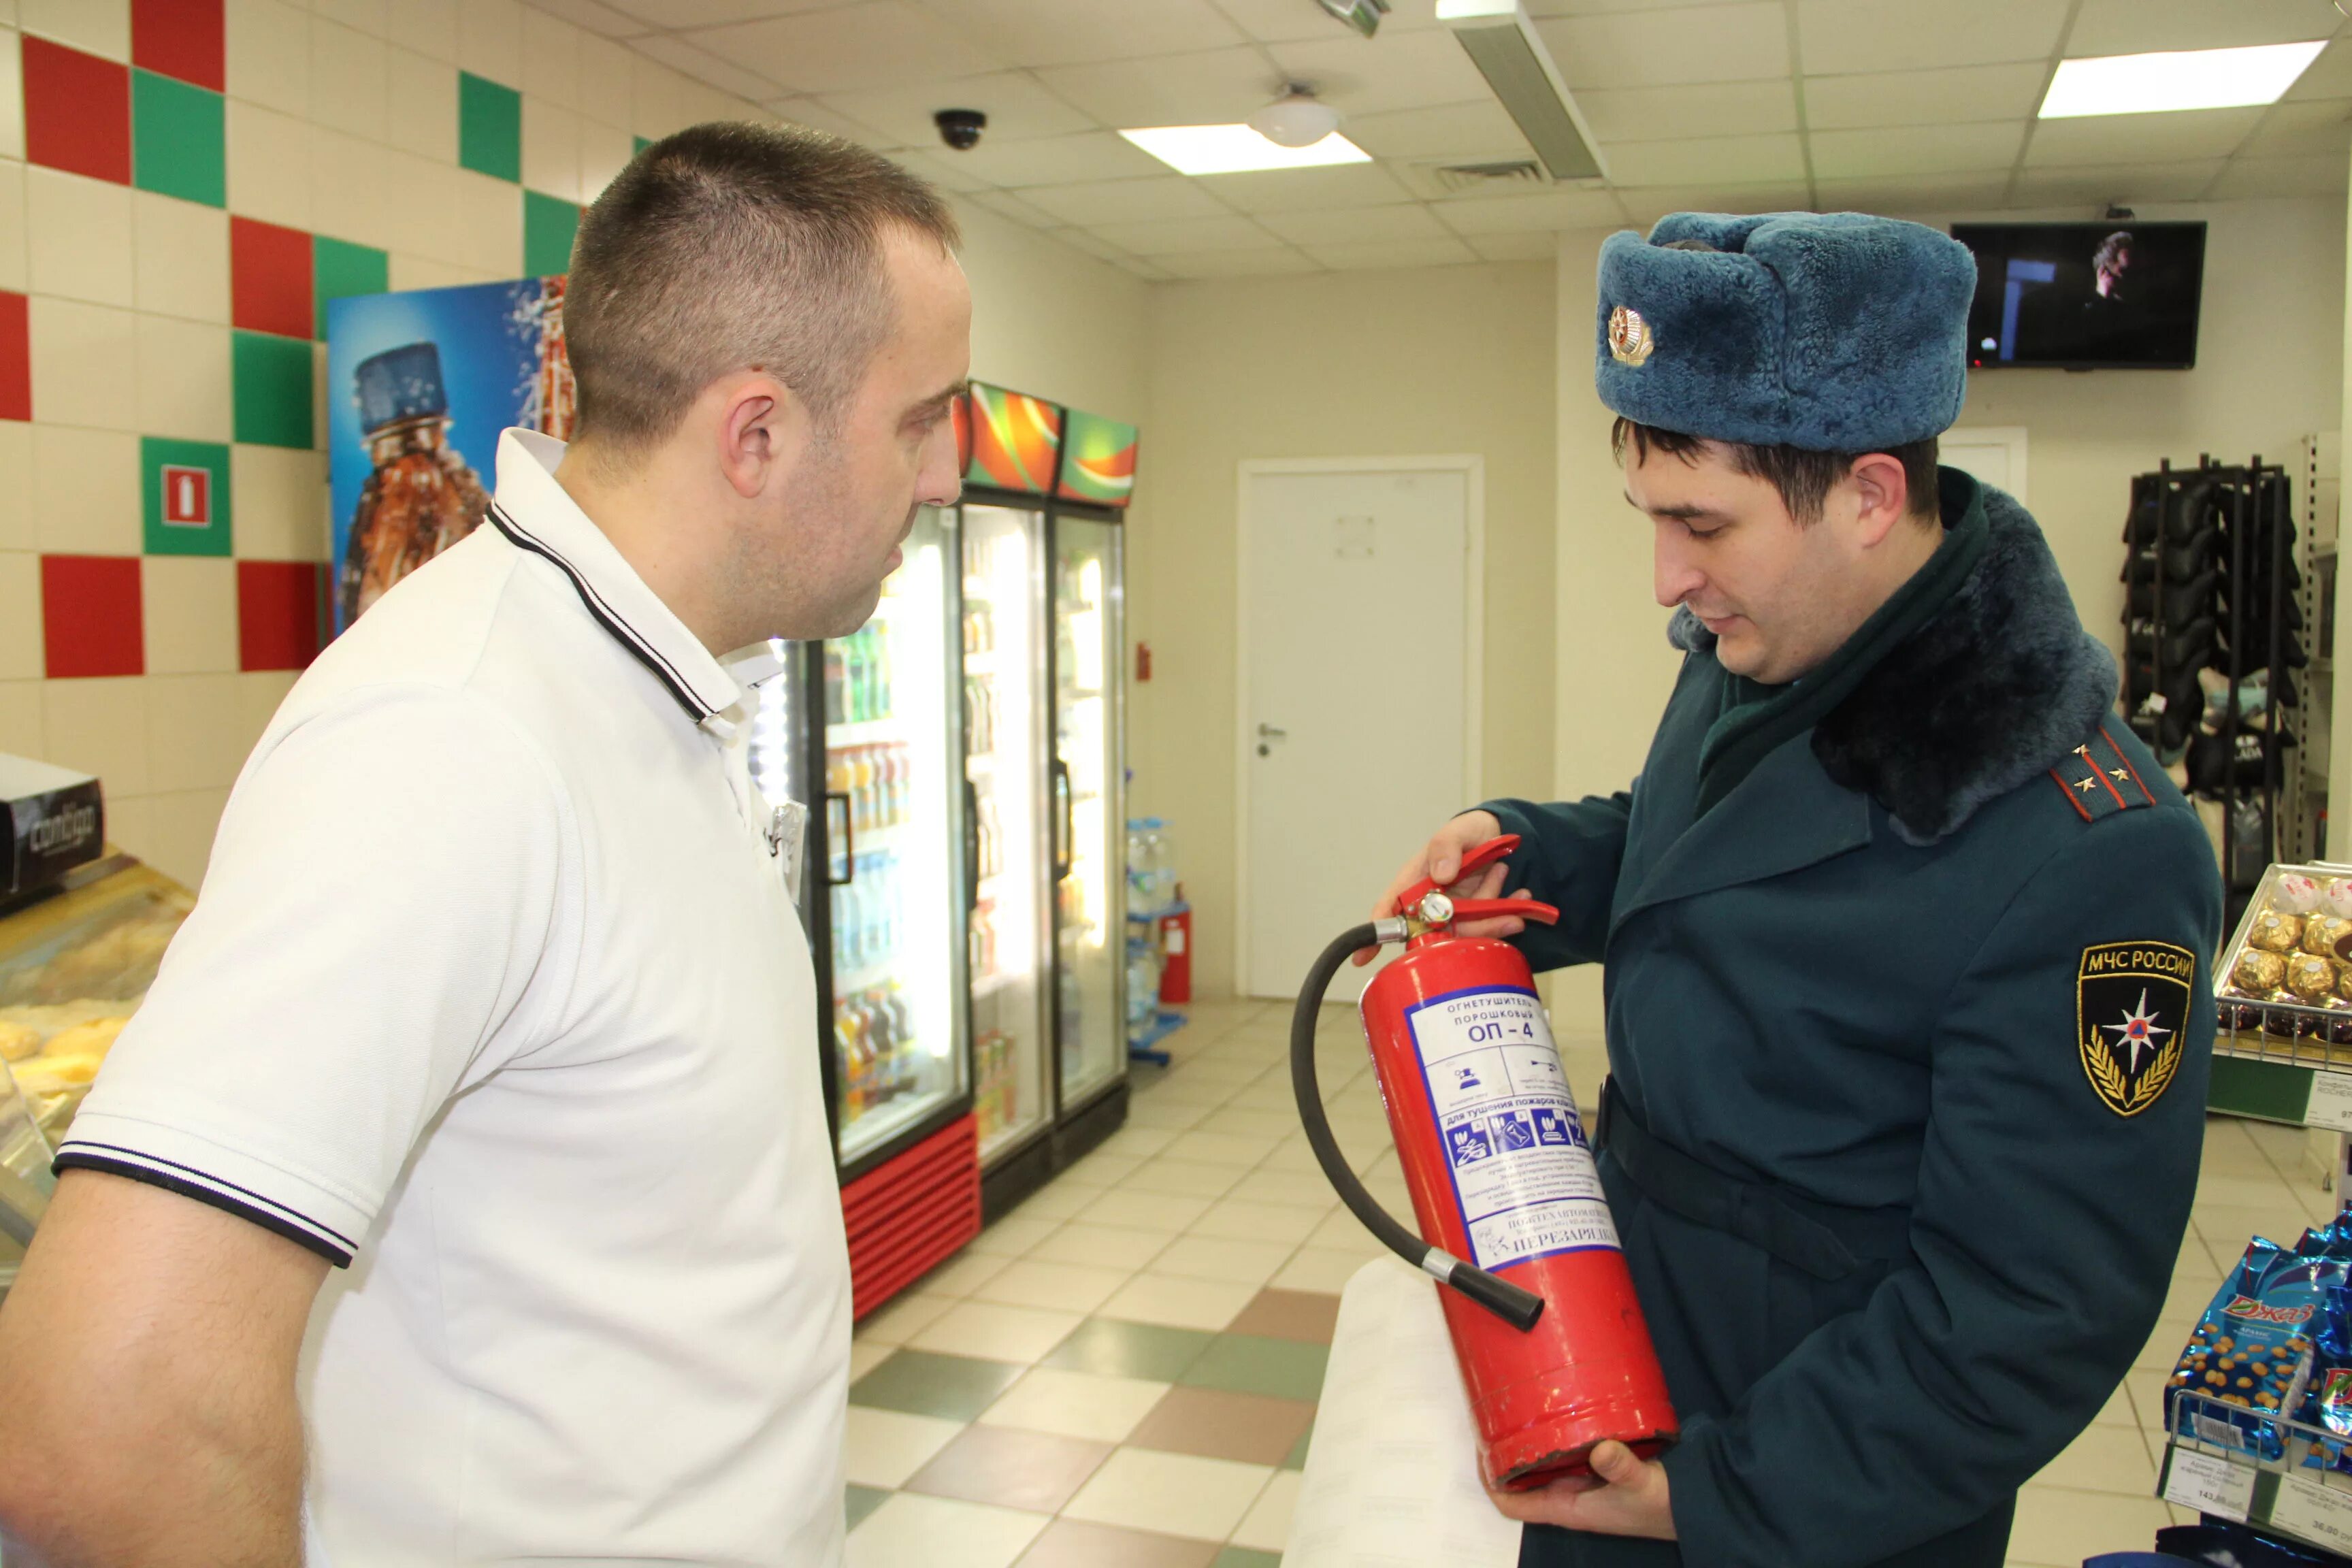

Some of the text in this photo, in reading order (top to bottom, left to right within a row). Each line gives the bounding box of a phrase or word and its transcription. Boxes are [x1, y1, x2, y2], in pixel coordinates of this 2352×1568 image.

[2088, 950, 2190, 978] МЧС РОССИИ
[1447, 997, 1533, 1013] ОГНЕТУШИТЕЛЬ
[1454, 1009, 1534, 1026] ПОРОШКОВЫЙ
[1468, 1022, 1503, 1043] ОП
[1523, 1022, 1533, 1039] 4
[1447, 1113, 1465, 1126] для
[1467, 1100, 1514, 1118] тушения
[1515, 1096, 1556, 1107] пожаров
[2219, 1293, 2316, 1324] Джаз
